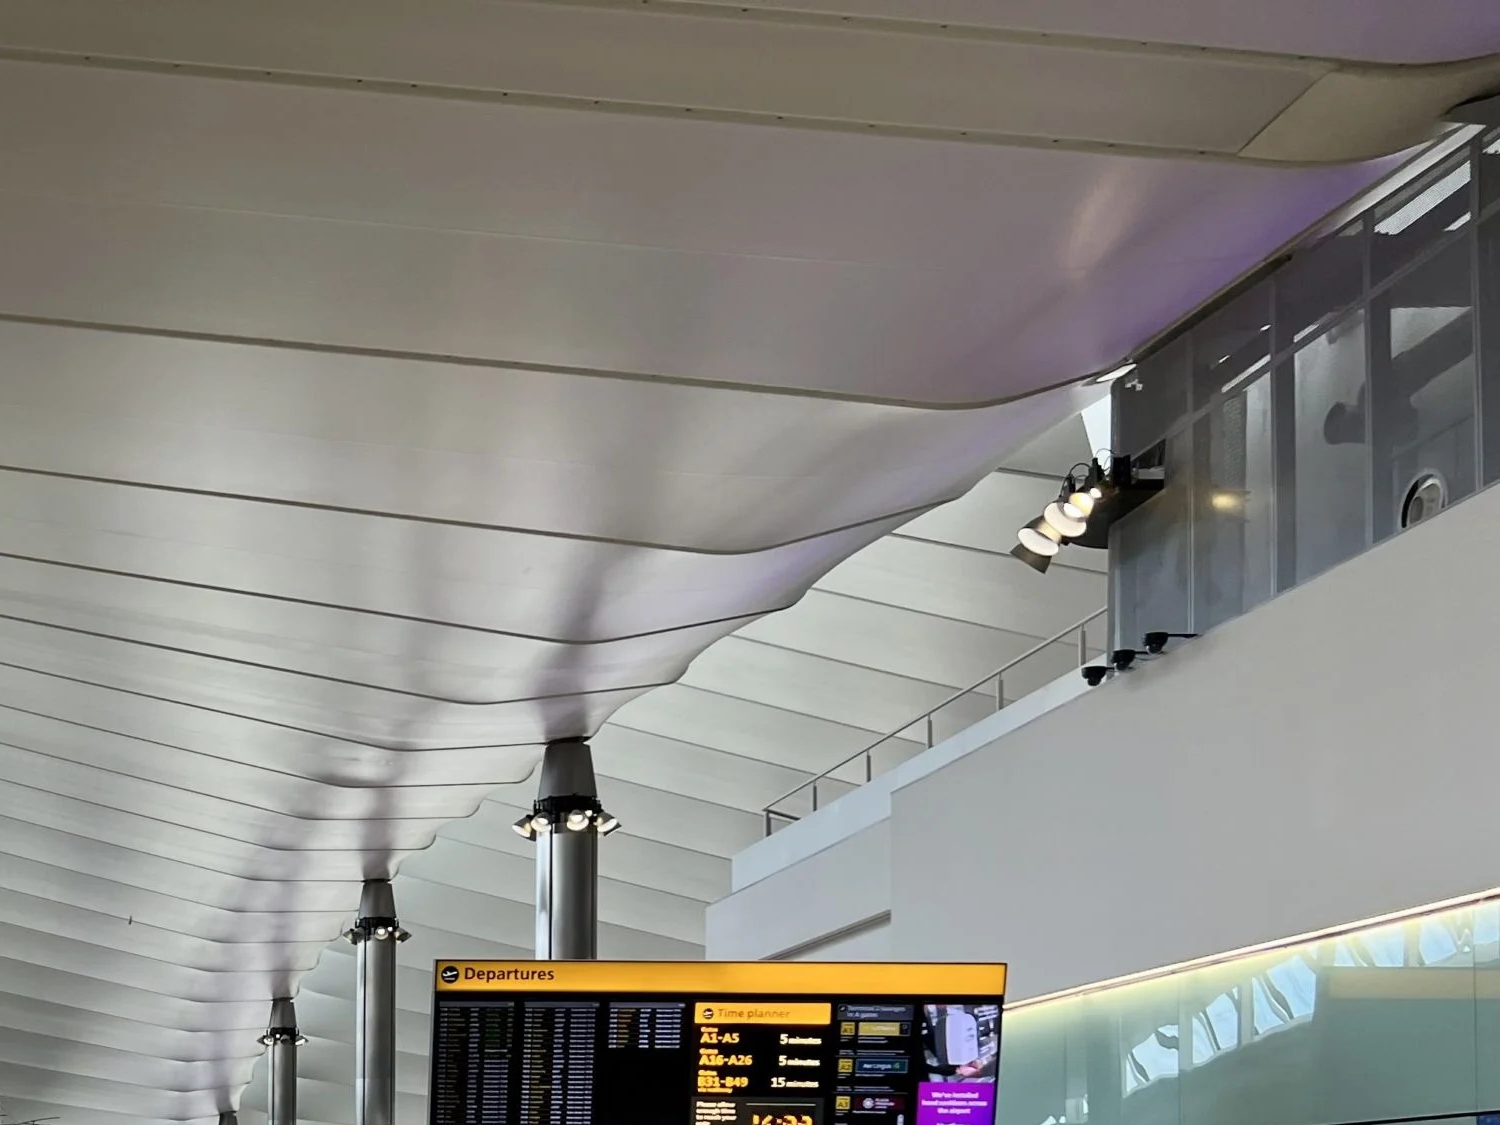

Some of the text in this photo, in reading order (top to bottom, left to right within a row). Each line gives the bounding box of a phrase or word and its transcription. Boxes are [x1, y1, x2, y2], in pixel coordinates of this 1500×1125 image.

[464, 967, 555, 983] Departures
[717, 1009, 744, 1018] Time
[700, 1033, 740, 1043] A1-A5
[780, 1034, 788, 1044] 5
[778, 1055, 787, 1066] 5
[770, 1077, 786, 1088] 15
